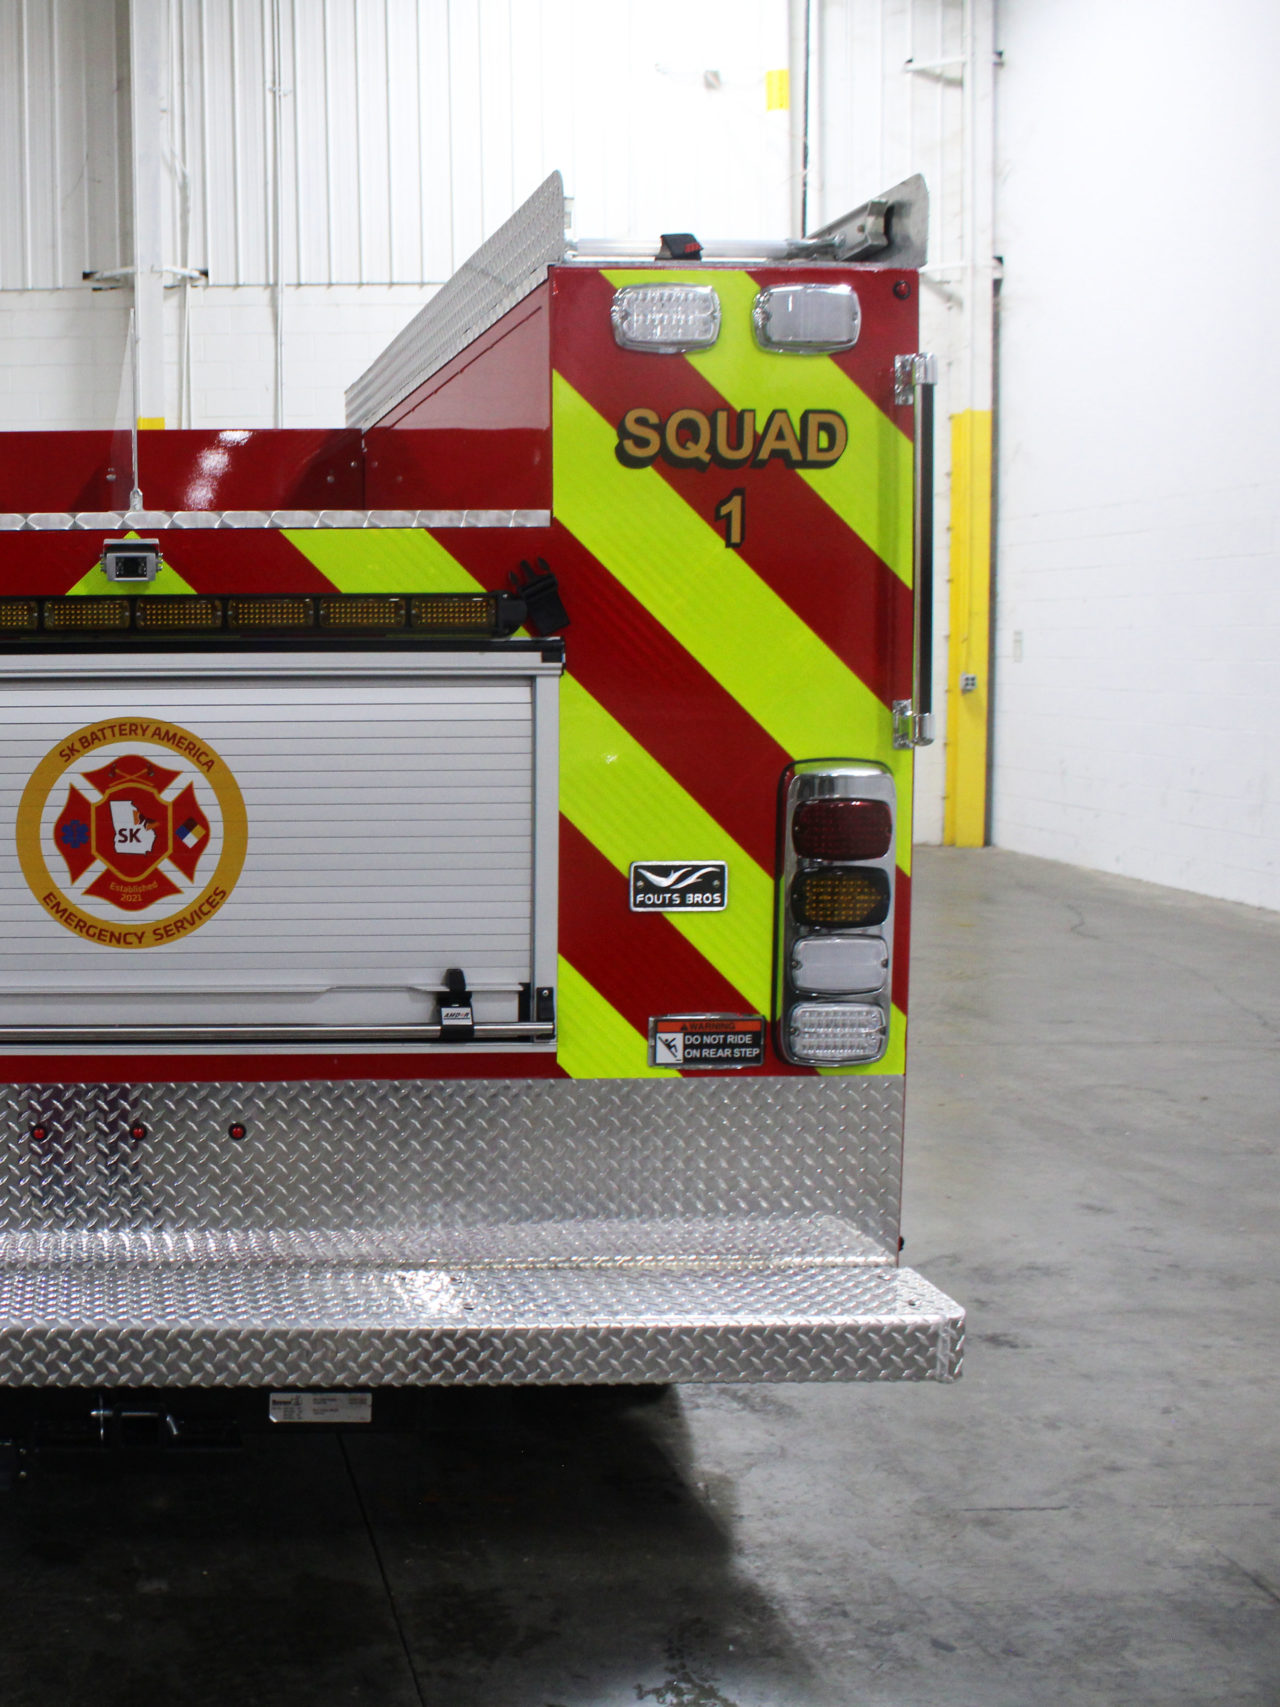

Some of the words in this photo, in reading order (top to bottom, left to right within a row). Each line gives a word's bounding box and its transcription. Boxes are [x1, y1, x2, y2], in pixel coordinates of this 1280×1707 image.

[615, 407, 848, 472] SQUAD
[715, 488, 745, 548] 1
[59, 743, 81, 763] SK
[78, 723, 151, 749] BATTERY
[151, 727, 216, 773] AMERICA
[118, 828, 141, 843] SK
[110, 880, 158, 893] Established
[120, 893, 143, 902] 2021
[636, 893, 681, 905] FOUTS
[686, 893, 722, 905] BROS
[42, 891, 146, 945] EMERGENCY
[153, 886, 227, 942] SERVICES
[689, 1022, 736, 1031] WARNING
[684, 1035, 701, 1045] DO
[703, 1035, 725, 1044] NOT
[727, 1034, 753, 1044] RIDE
[684, 1049, 700, 1058] ON
[702, 1048, 732, 1058] REAR
[733, 1048, 760, 1057] STEP
